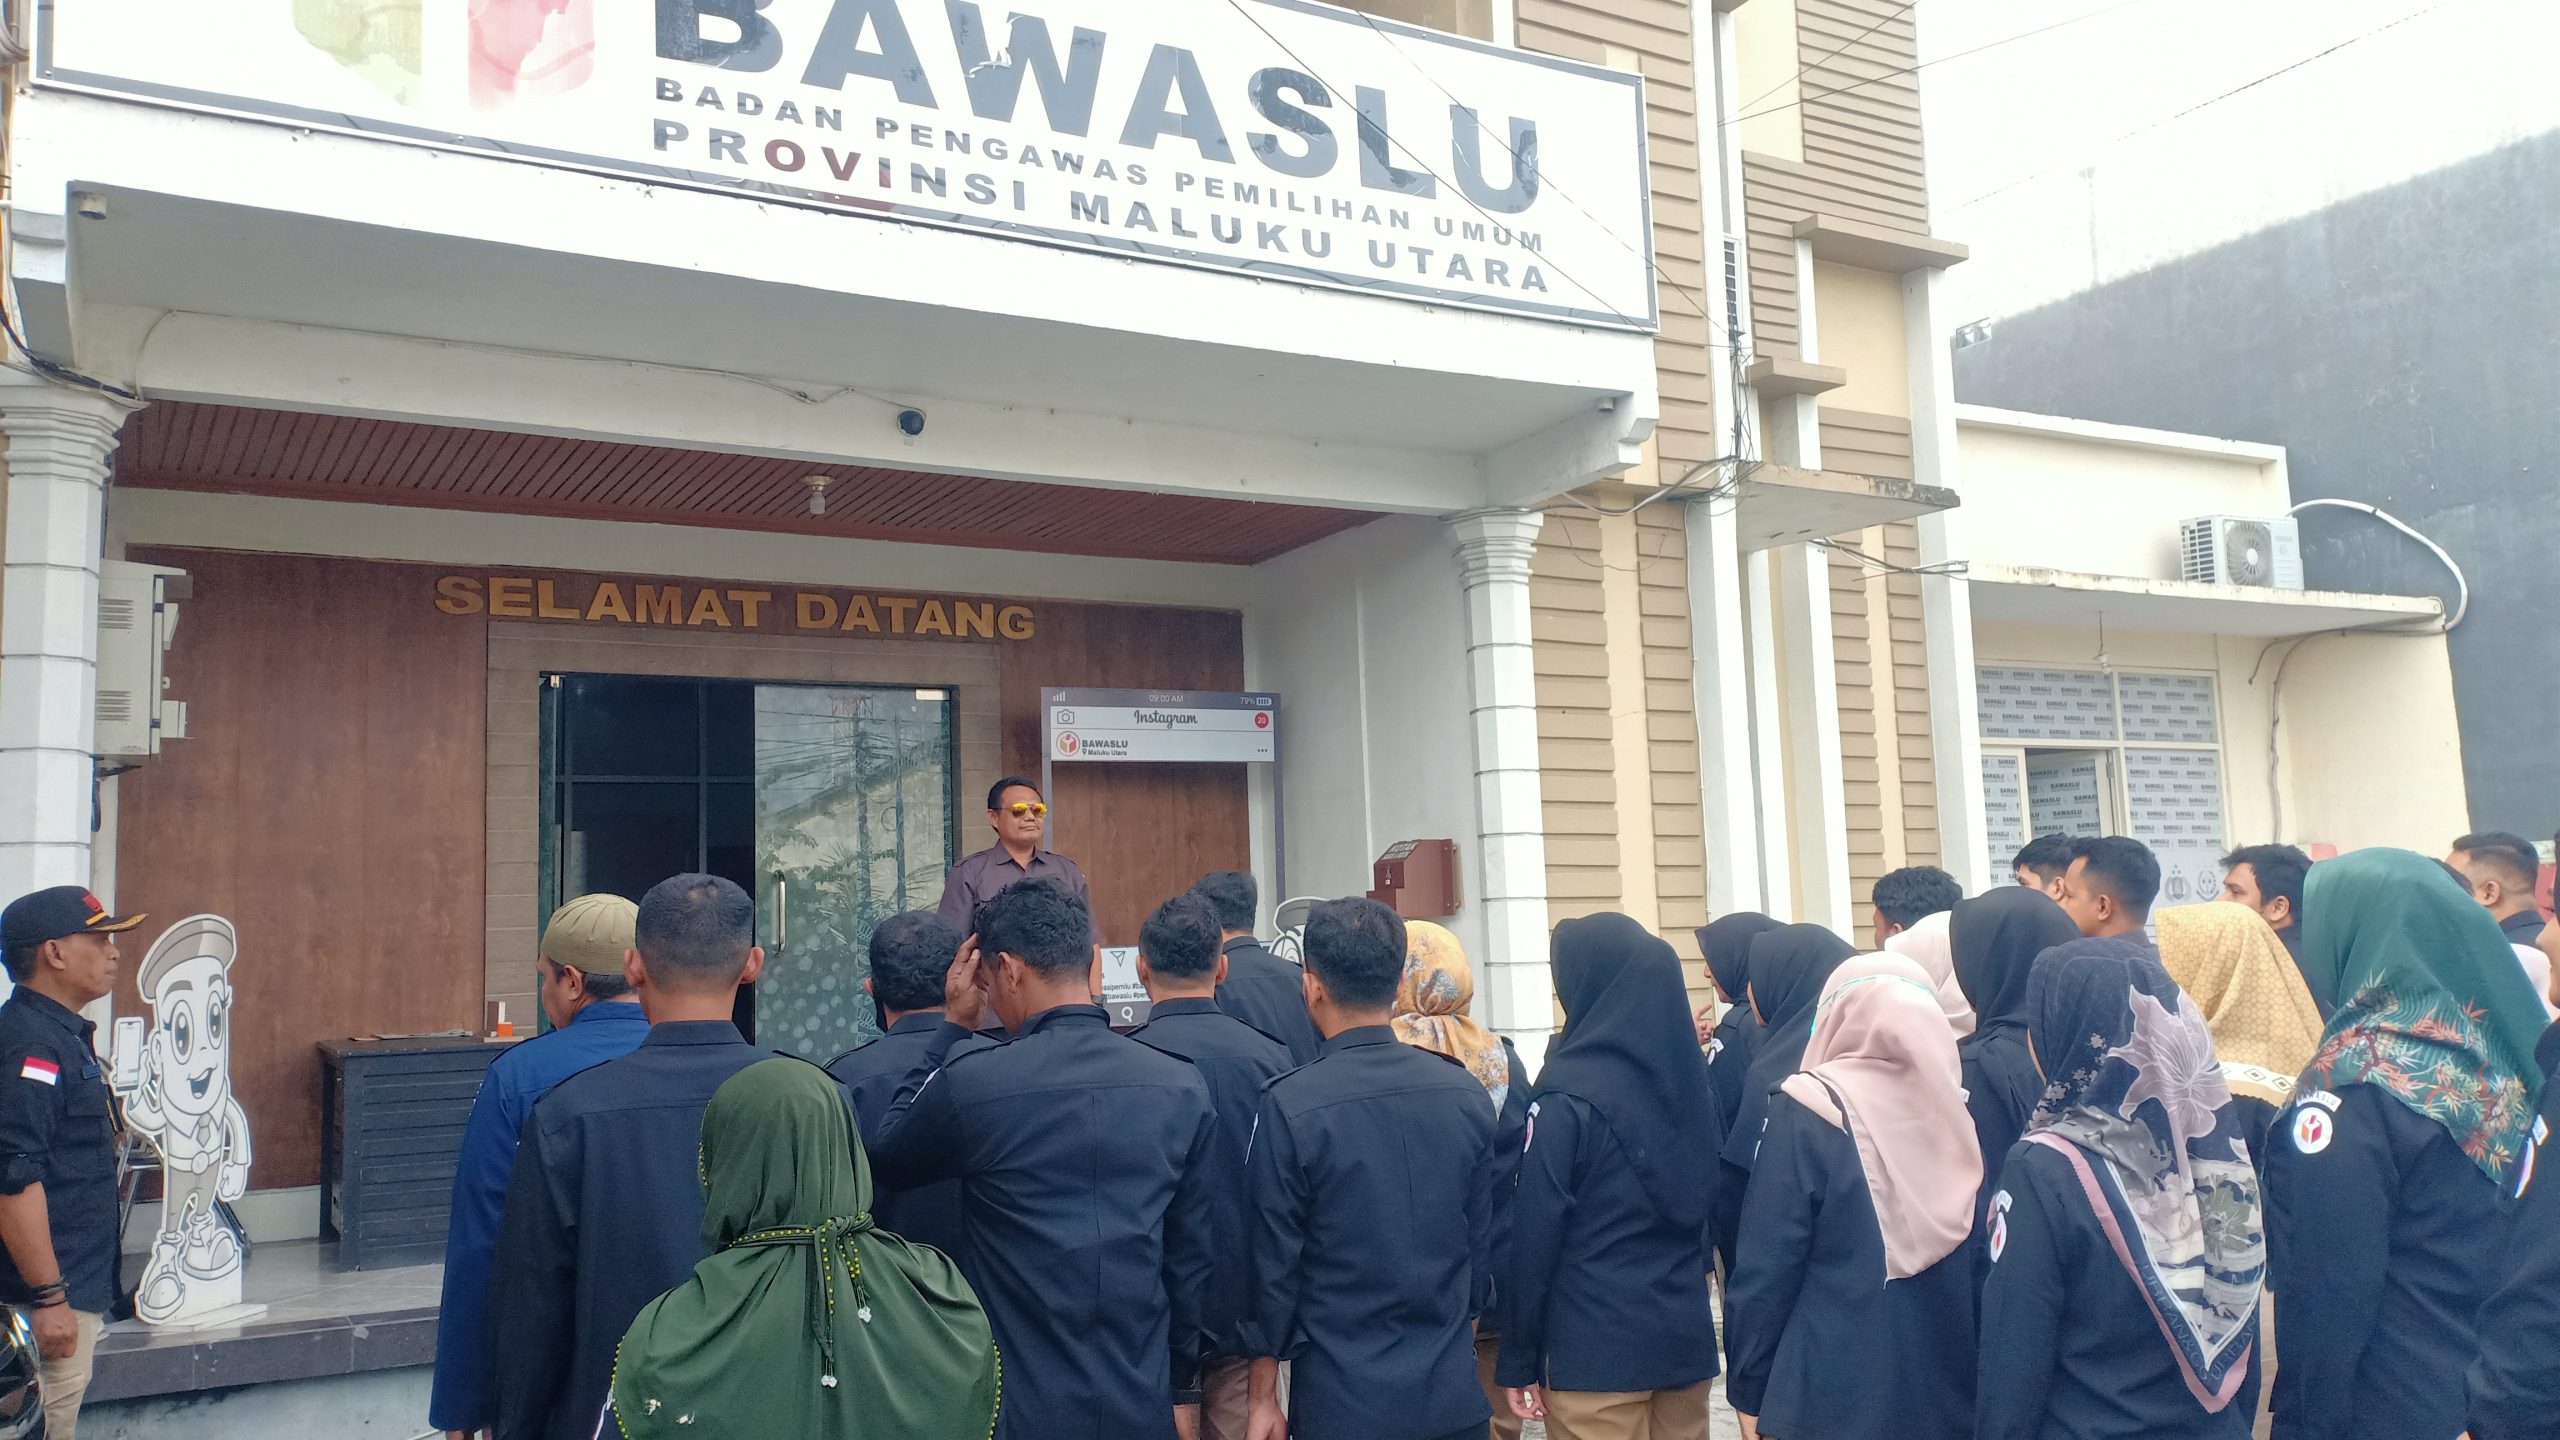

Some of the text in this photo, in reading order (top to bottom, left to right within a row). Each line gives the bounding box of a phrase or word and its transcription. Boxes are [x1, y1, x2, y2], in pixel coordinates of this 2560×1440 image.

[655, 0, 1539, 214] BAWASLU
[655, 76, 1542, 252] BADAN PENGAWAS PEMILIHAN UMUM
[653, 118, 1548, 293] PROVINSI MALUKU UTARA
[434, 576, 1035, 640] SELAMAT DATANG
[1134, 710, 1198, 729] Instagram
[1171, 695, 1184, 703] AM
[1082, 740, 1128, 748] BAWASLU
